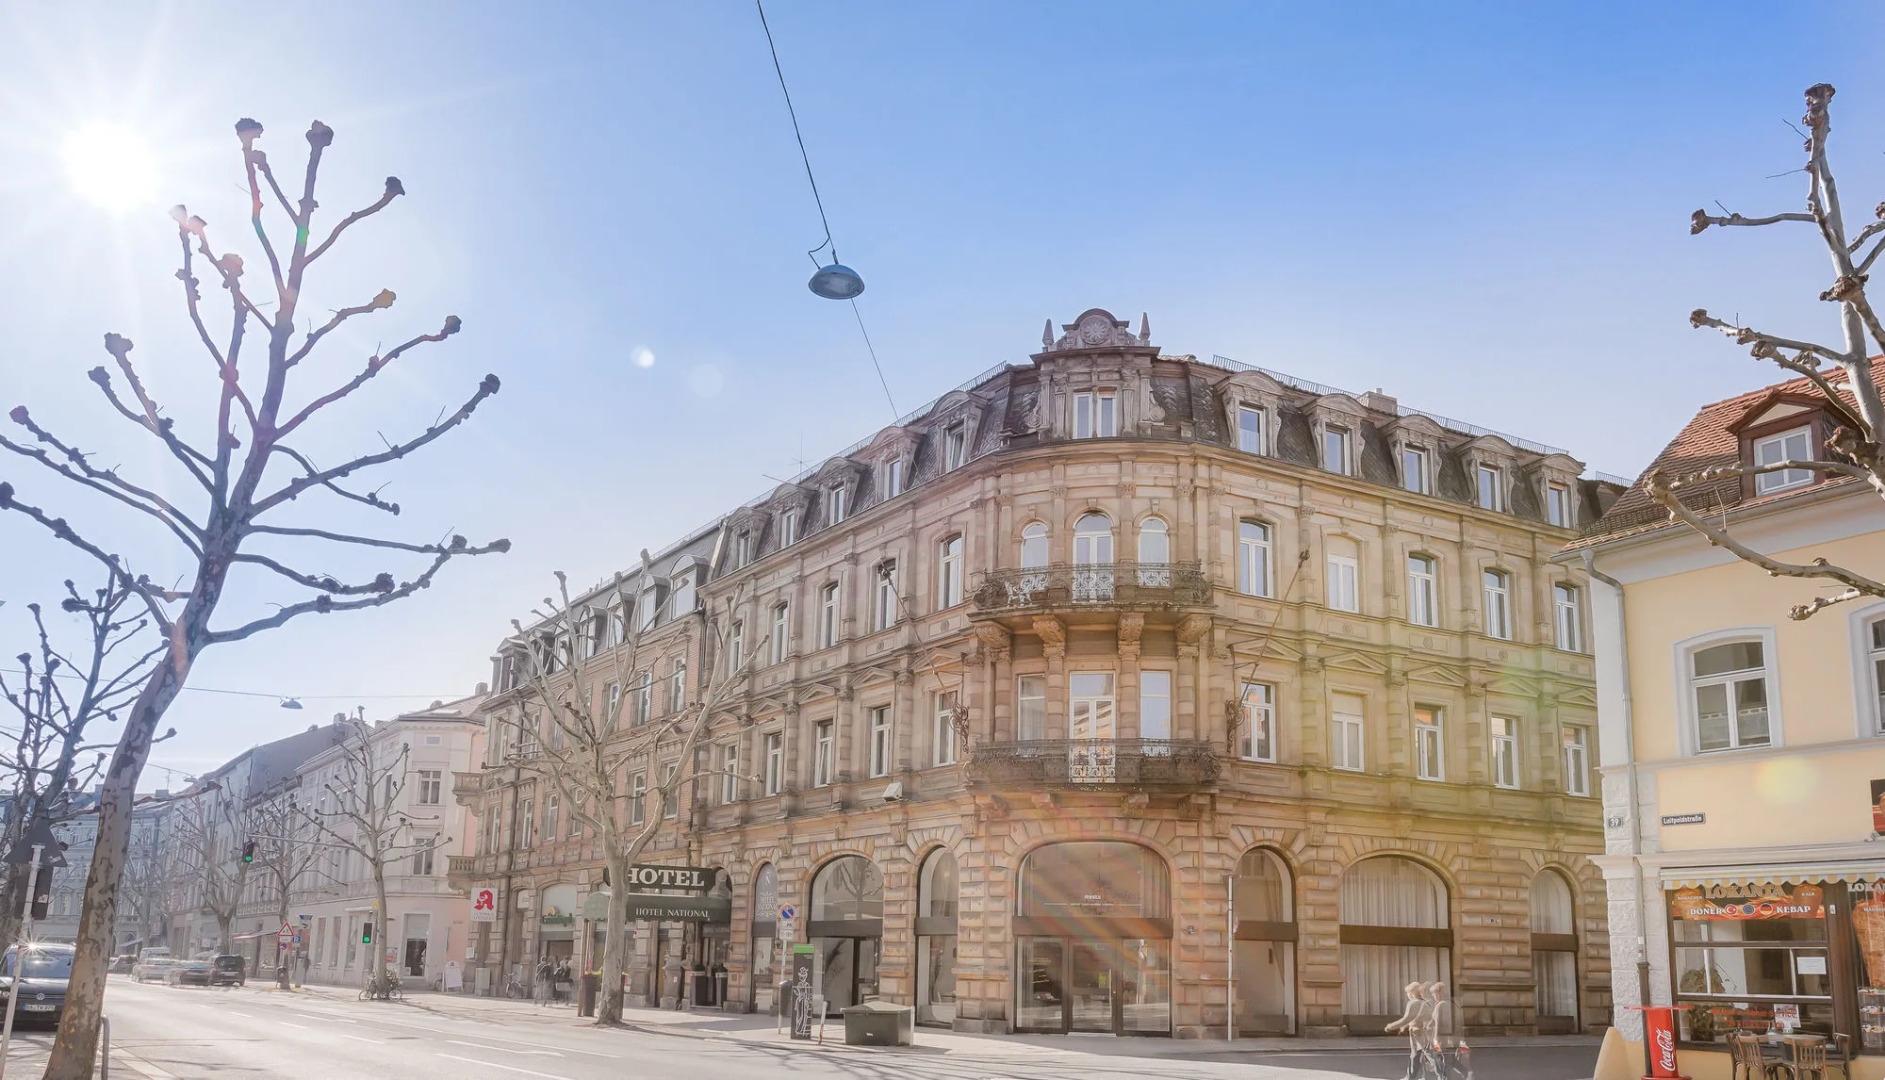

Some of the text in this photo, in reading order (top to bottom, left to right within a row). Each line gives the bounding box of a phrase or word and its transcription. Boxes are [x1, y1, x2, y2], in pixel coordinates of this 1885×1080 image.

[1662, 815, 1702, 825] Luitpoldstraße
[628, 867, 705, 887] HOTEL
[1705, 884, 1785, 899] LOKANTA
[1847, 882, 1885, 892] LOKA
[636, 907, 710, 918] HOTEL NATIONAL
[1776, 905, 1811, 914] KEBAP
[1655, 1028, 1675, 1071] Coca-Cola
